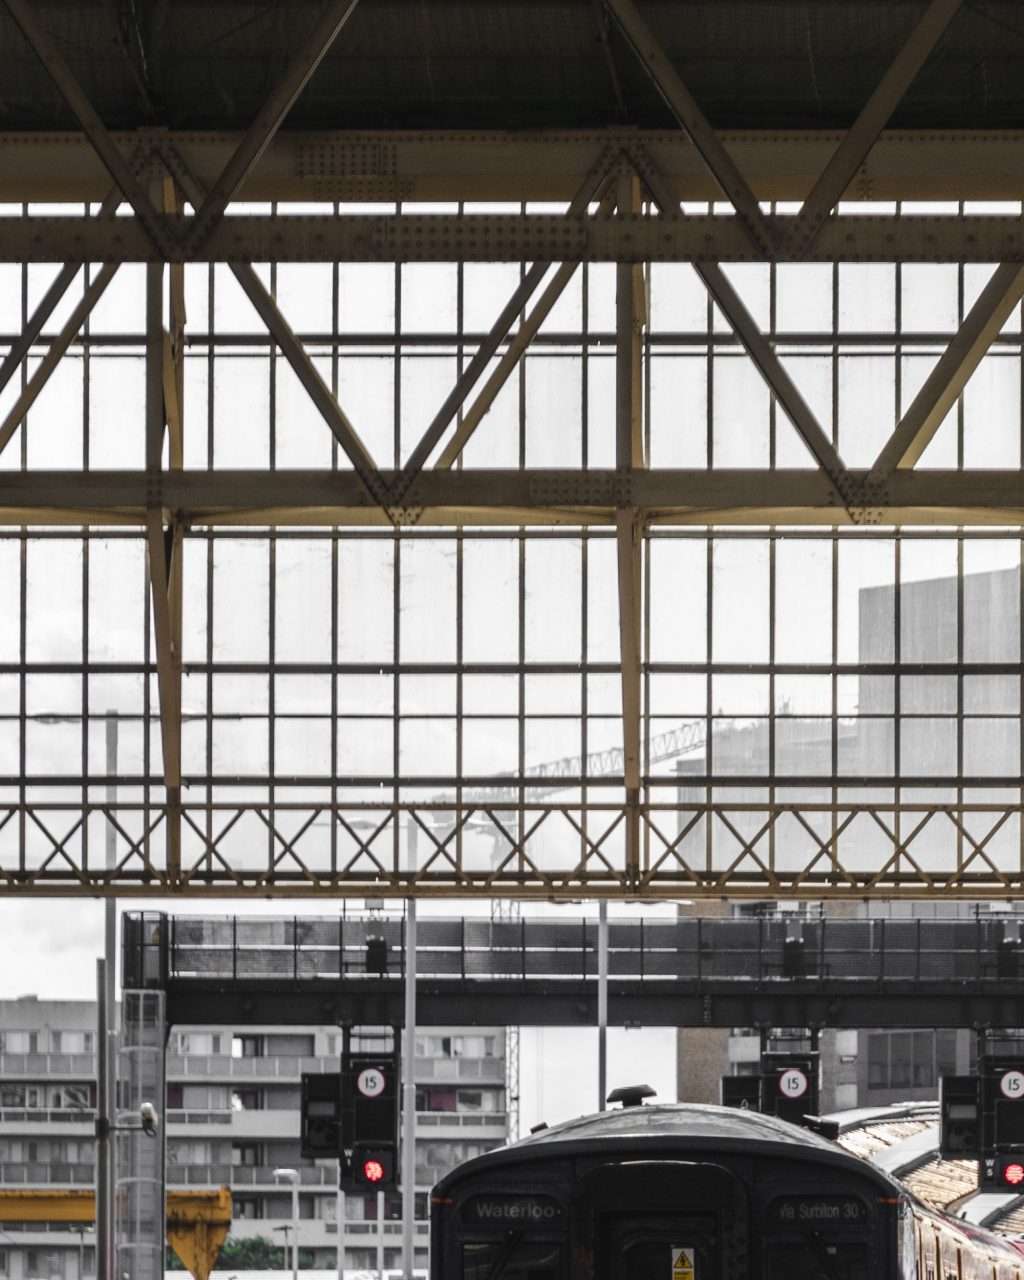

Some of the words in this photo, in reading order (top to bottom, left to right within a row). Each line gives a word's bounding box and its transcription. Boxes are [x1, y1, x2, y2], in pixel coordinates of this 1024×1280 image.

[365, 1076, 377, 1089] 15
[787, 1078, 800, 1090] 15
[1008, 1078, 1020, 1091] 15
